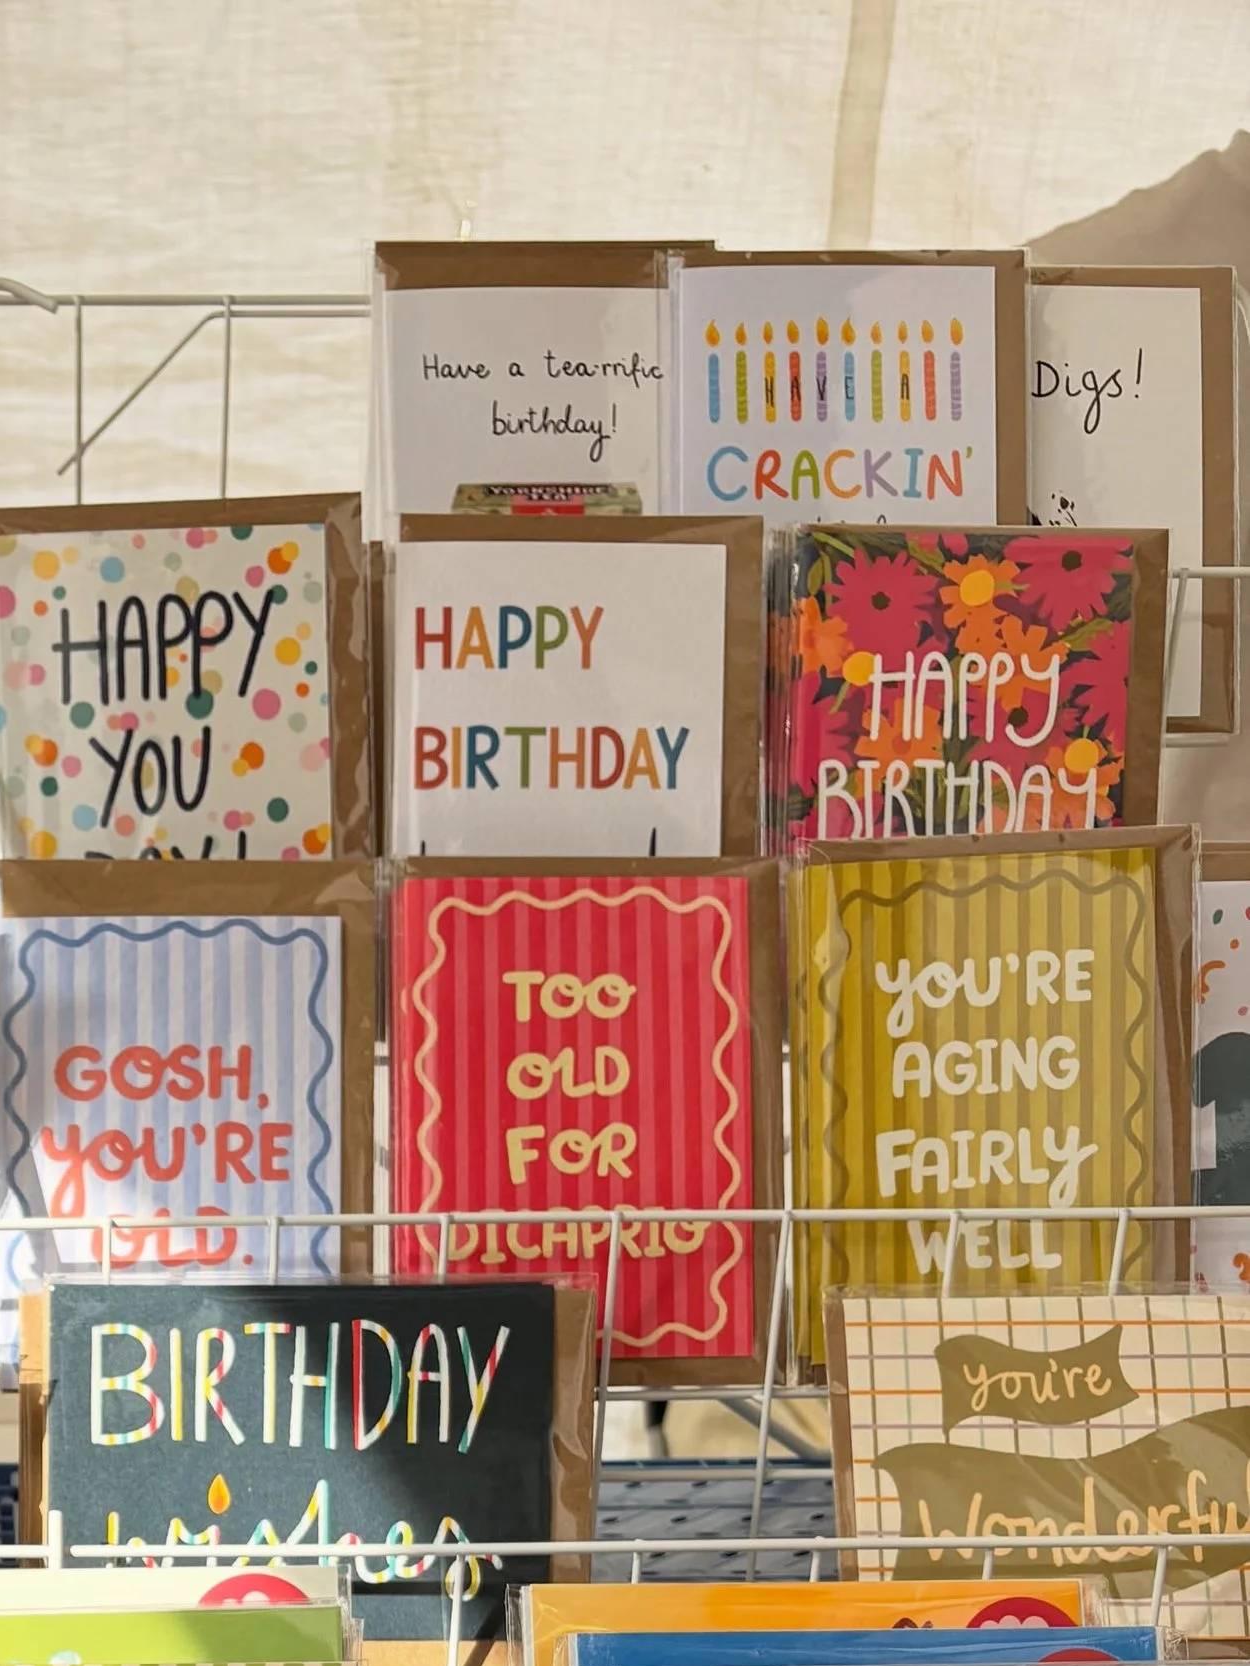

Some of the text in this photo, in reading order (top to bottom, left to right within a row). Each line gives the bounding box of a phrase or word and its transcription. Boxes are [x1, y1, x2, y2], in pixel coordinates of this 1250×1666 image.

[423, 353, 490, 380] Have
[508, 362, 525, 377] a
[1031, 347, 1143, 435] Digs!
[492, 400, 617, 463] birthday!
[706, 446, 973, 502] CRACKIN'
[52, 589, 275, 705] HAPPY
[414, 605, 605, 670] HAPPY
[869, 650, 1062, 748] HAPPY
[89, 726, 211, 828] YOU
[413, 726, 690, 791] BIRTHDAY
[817, 758, 1098, 840] BIRTHDAY
[502, 970, 636, 1022] TOO
[53, 1044, 270, 1109] GOSH,
[506, 1046, 630, 1099] OLD
[892, 1035, 1080, 1098] AGING
[505, 1122, 637, 1185] FOR
[875, 1124, 1098, 1209] FAIRLY
[90, 1206, 254, 1270] OLD.
[446, 1204, 712, 1264] DICAPRIO
[906, 1218, 1062, 1275] WELL
[91, 1320, 510, 1454] BIRTHDAY
[963, 1358, 1112, 1411] you're
[918, 1469, 1250, 1567] Wonderfu
